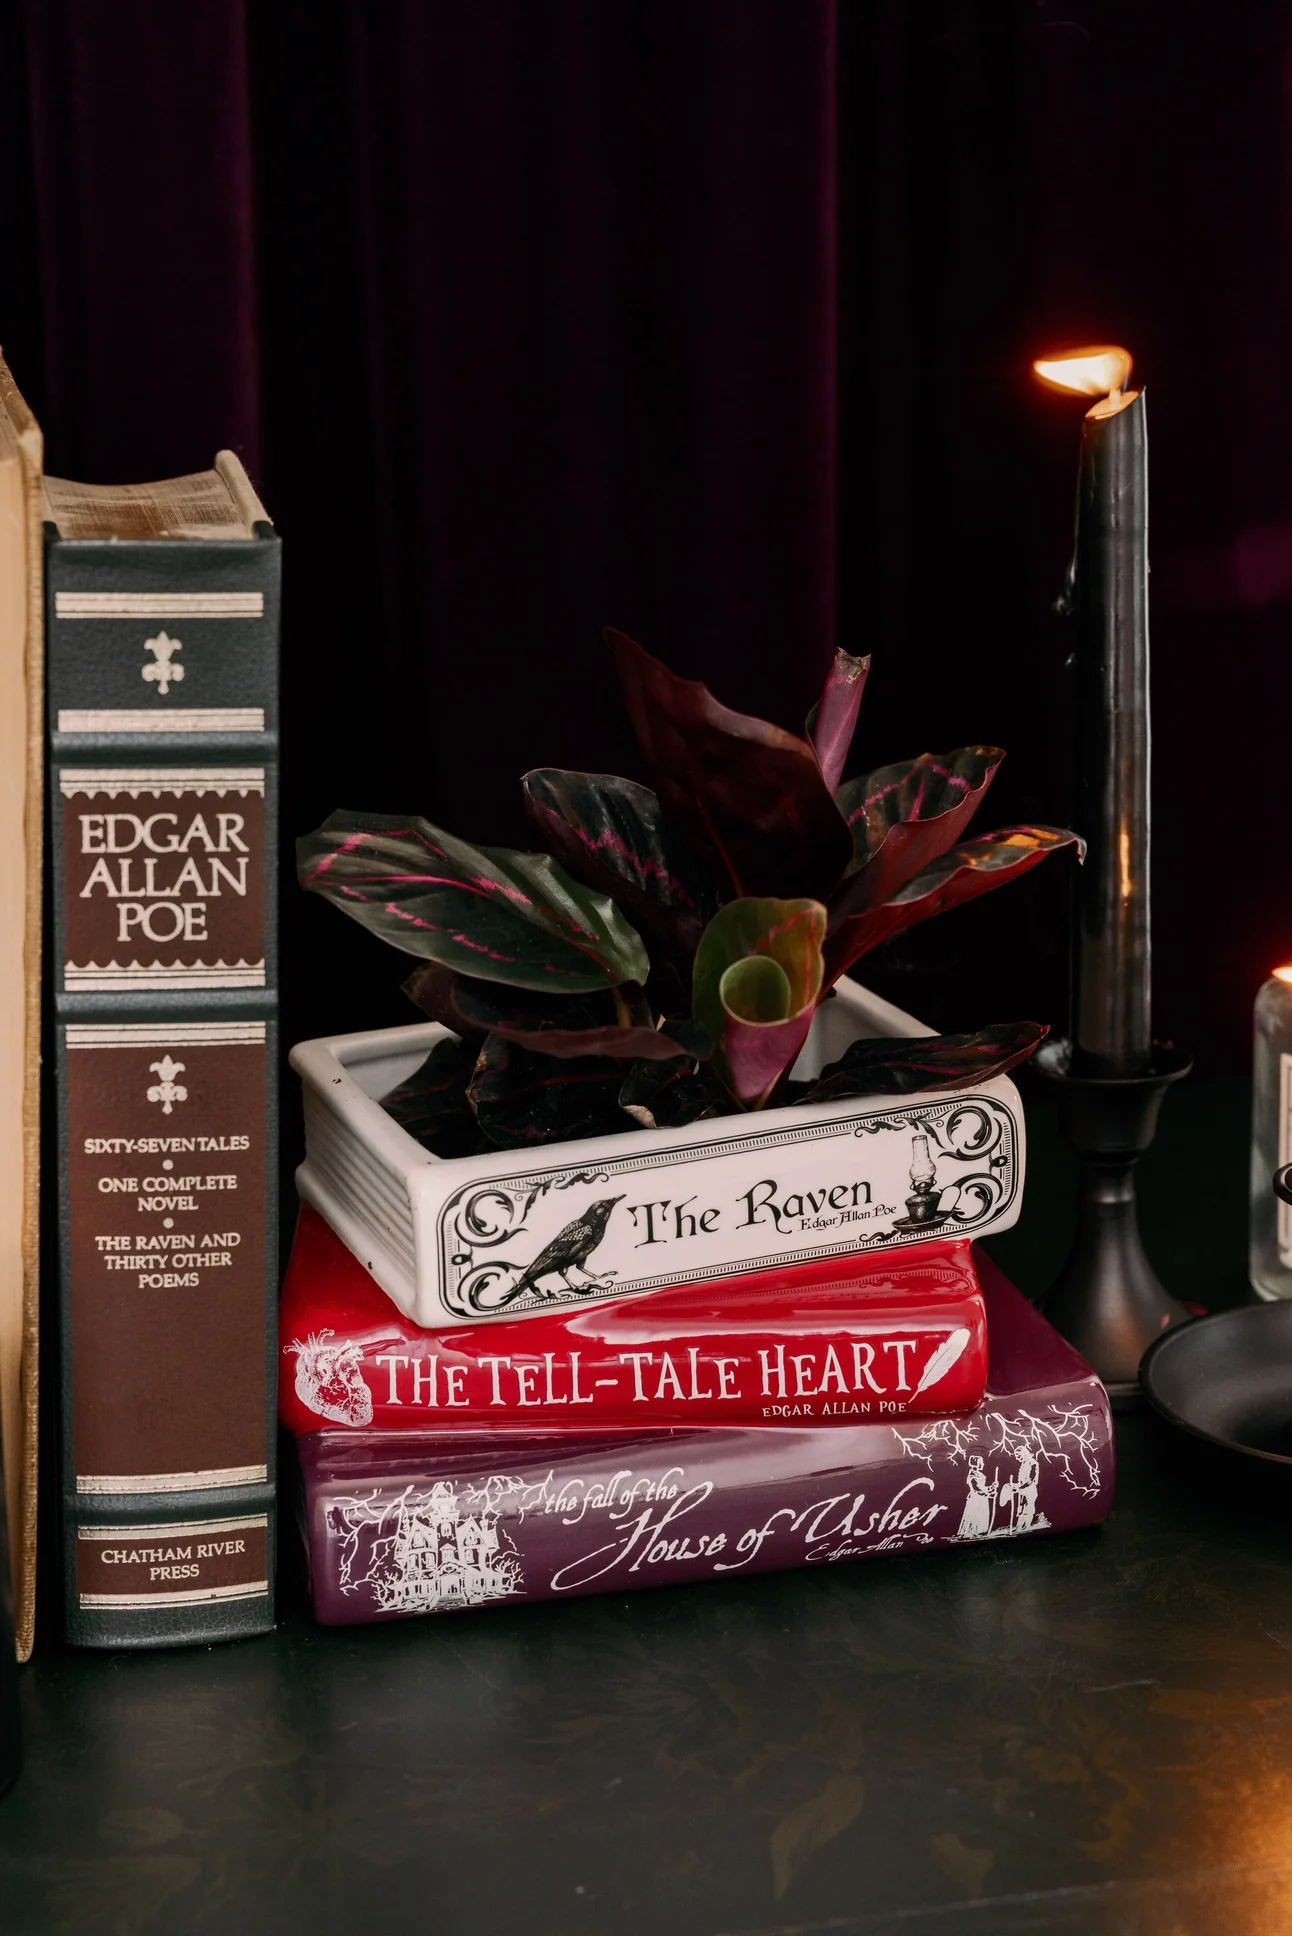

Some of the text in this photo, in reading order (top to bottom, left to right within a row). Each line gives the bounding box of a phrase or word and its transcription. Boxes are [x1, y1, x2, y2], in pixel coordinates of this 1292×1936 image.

[78, 813, 249, 853] EDGAR
[79, 856, 249, 897] ALLAN
[116, 901, 208, 942] POE
[84, 1135, 250, 1153] SIXTY-SEVEN TALES
[98, 1175, 237, 1192] ONE COMPLETE
[138, 1196, 199, 1211] NOVEL
[626, 1179, 873, 1249] The Raven
[798, 1204, 897, 1231] Edgar Allan Poe
[95, 1233, 241, 1251] THE RAVEN AND
[104, 1252, 232, 1270] THIRTY OTHER
[138, 1273, 199, 1288] POEMS
[376, 1354, 469, 1408] THE
[757, 1340, 916, 1398] HEART
[762, 1400, 907, 1418] EDGAR ALLAN POE
[544, 1467, 684, 1525] the fall of the
[550, 1477, 948, 1590] House of Usher
[101, 1539, 246, 1564] CHATHAM RIVER
[805, 1539, 860, 1561] Edgar
[858, 1533, 903, 1554] Allan
[150, 1564, 200, 1581] PRESS
